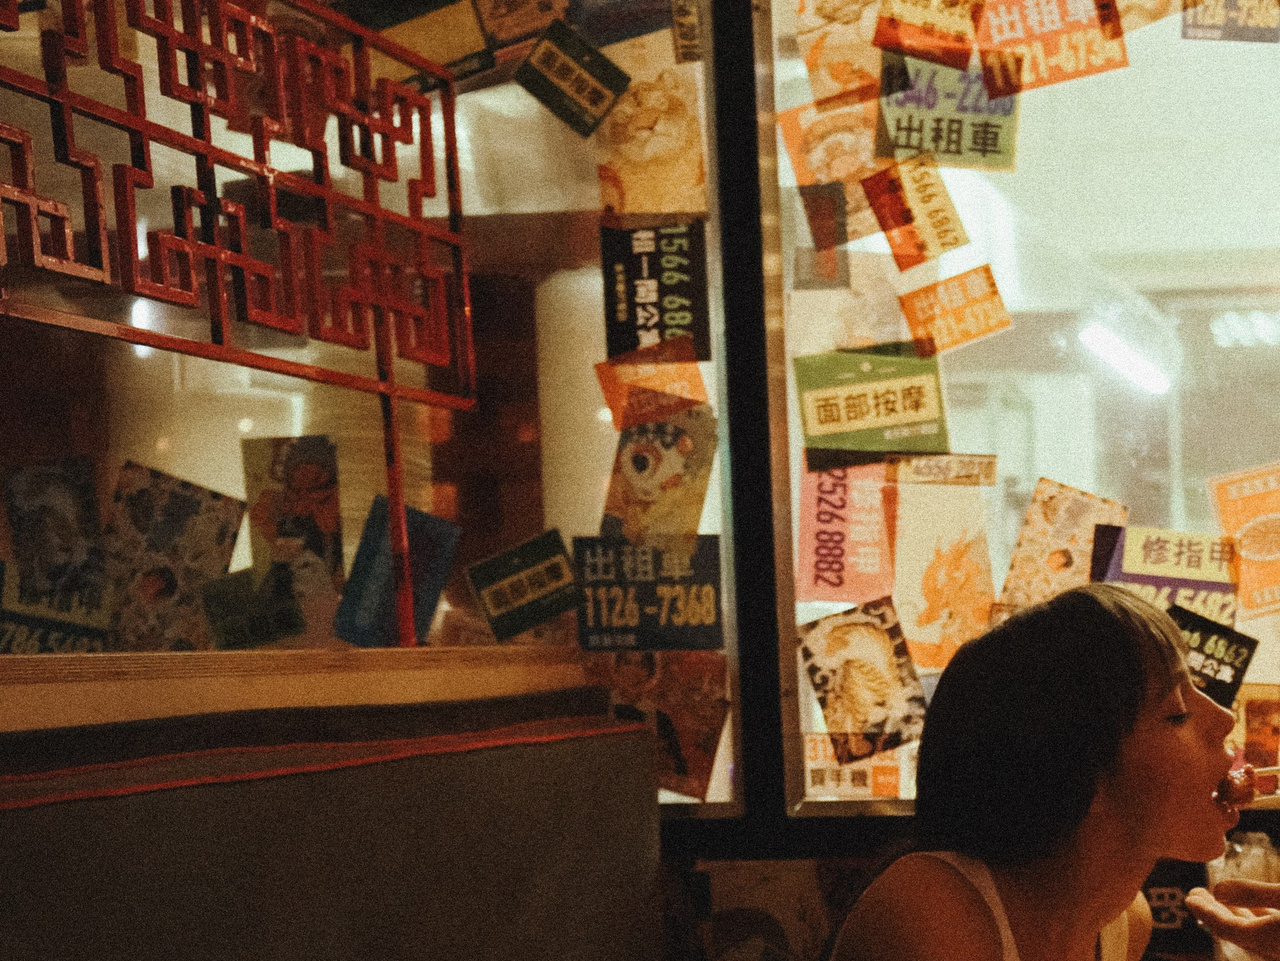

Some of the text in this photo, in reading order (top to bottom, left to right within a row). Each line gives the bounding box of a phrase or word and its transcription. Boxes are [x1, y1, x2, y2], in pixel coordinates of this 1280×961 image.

[893, 114, 1003, 158] 出租車
[660, 223, 691, 286] 1566
[814, 385, 926, 426] 面部按摩
[583, 545, 695, 582] 出租車
[814, 530, 845, 588] 8882
[1141, 535, 1236, 571] 修指甲
[583, 583, 717, 629] 1126-7368
